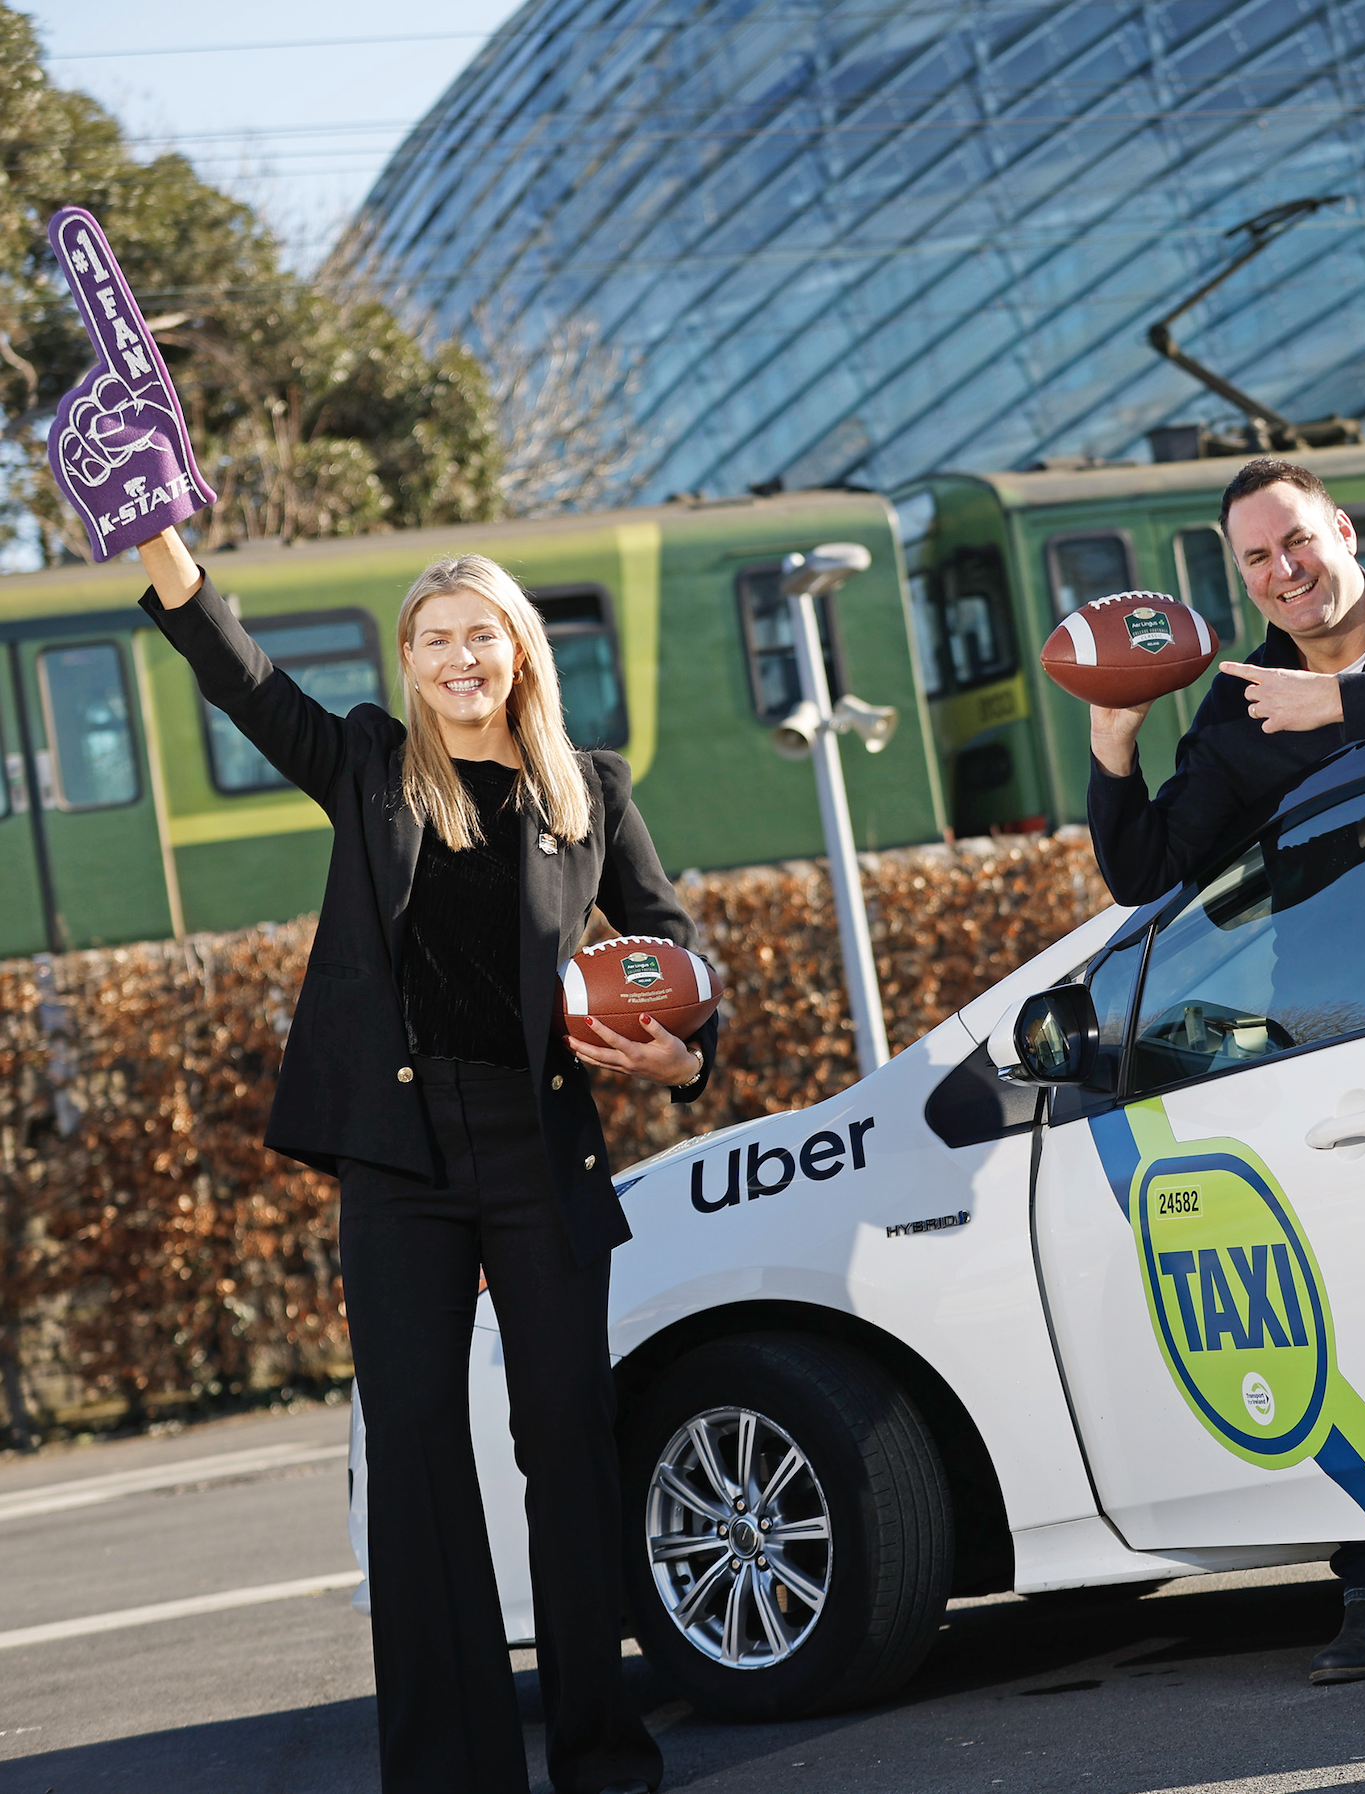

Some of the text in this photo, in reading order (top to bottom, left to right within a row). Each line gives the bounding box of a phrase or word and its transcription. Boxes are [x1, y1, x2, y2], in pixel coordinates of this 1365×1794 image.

[71, 228, 110, 283] #1
[96, 286, 152, 379] FAN
[98, 471, 193, 537] K-STATE
[690, 1116, 875, 1214] Uber
[886, 1215, 956, 1238] HYBRID
[1158, 1190, 1200, 1216] 24582
[1158, 1243, 1309, 1352] TAXI
